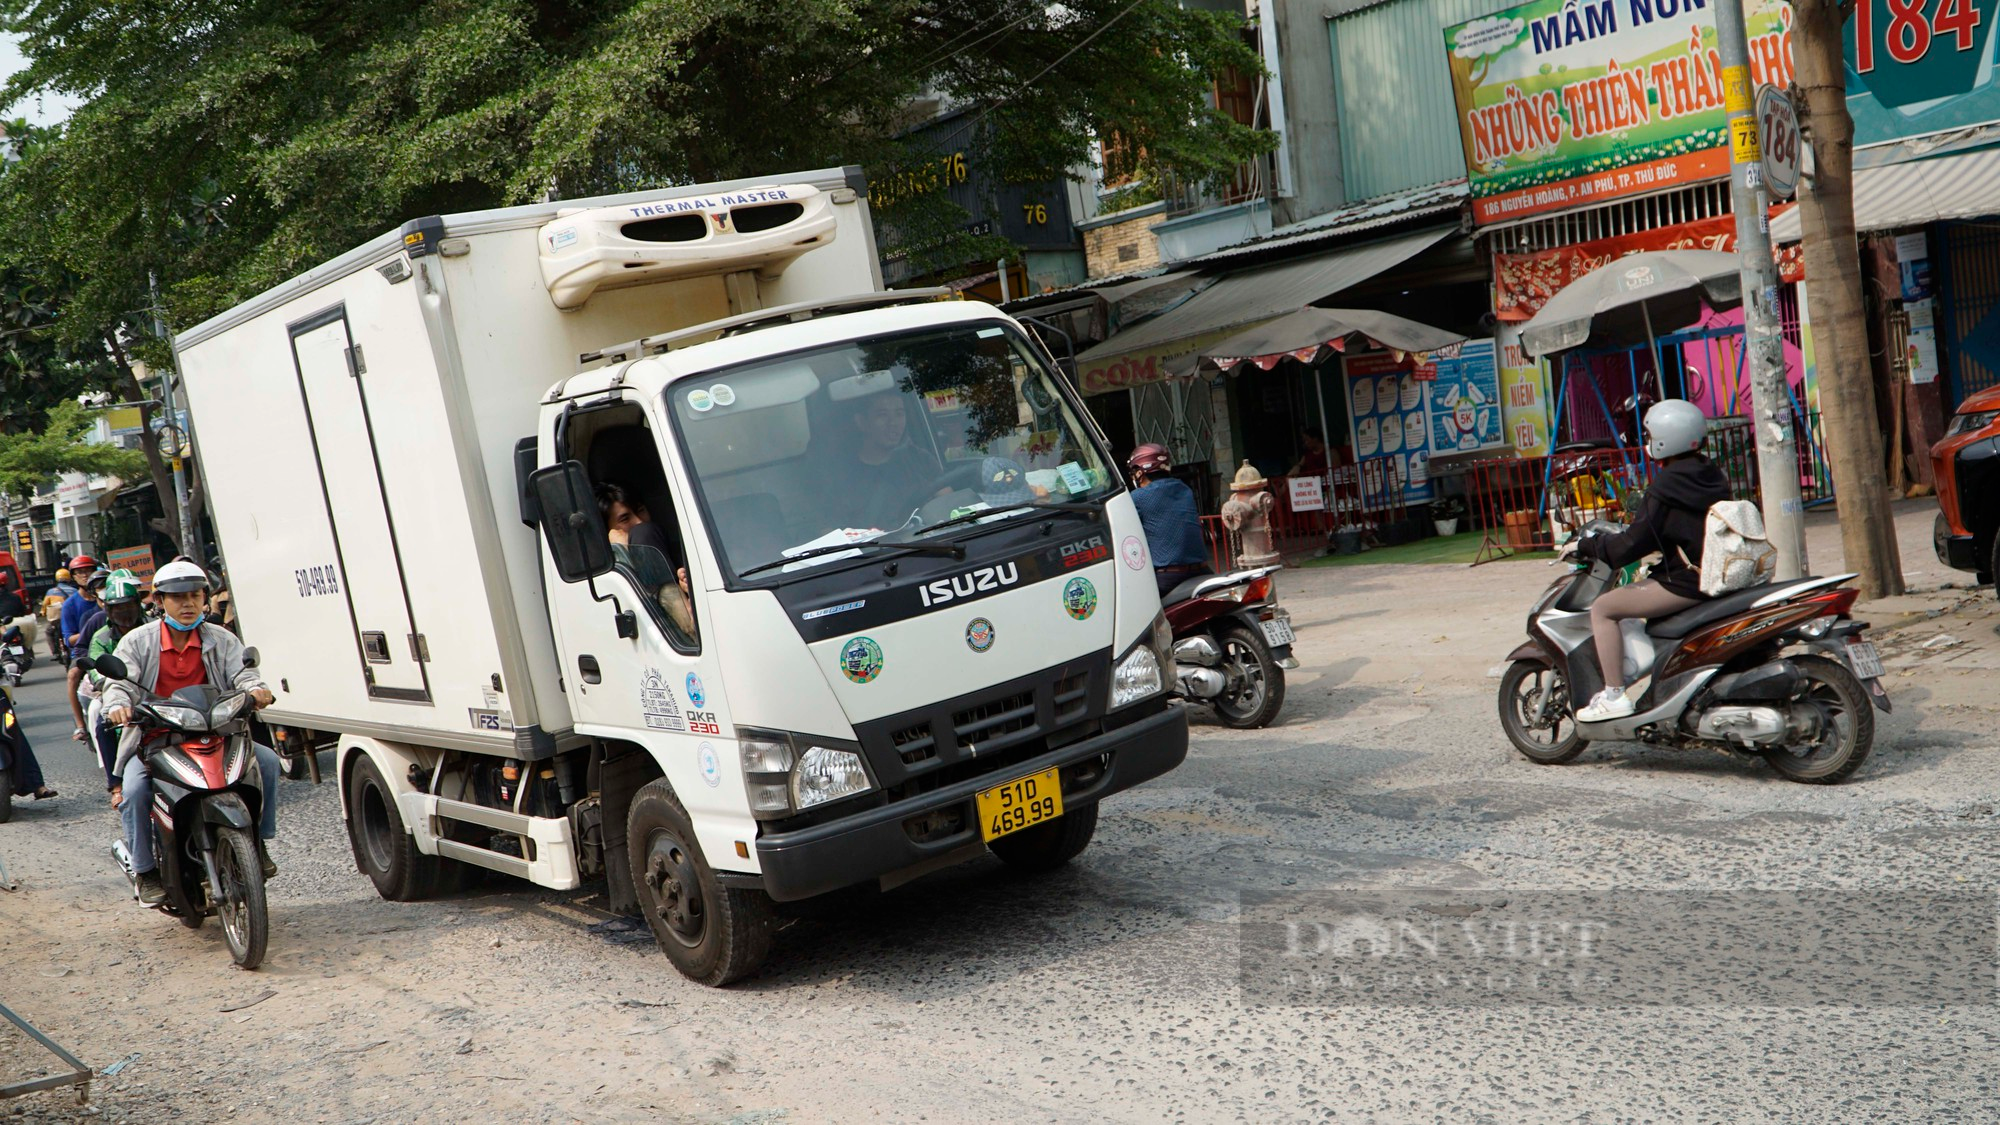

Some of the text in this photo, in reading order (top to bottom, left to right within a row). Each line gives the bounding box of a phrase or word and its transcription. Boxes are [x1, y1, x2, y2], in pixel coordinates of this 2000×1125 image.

[1855, 0, 1980, 74] 184
[1469, 85, 1562, 163] NHỮNG
[1564, 57, 1649, 139] THIÊN
[1738, 130, 1758, 147] 73
[1764, 113, 1796, 170] 184
[942, 152, 967, 187] 76
[1484, 202, 1500, 217] 186
[1569, 186, 1579, 198] P.
[1581, 182, 1593, 196] AN
[1595, 175, 1618, 193] PHÚ,
[1618, 172, 1634, 188] TP.
[1635, 164, 1655, 184] THỦ
[1656, 161, 1678, 181] ĐỨC
[630, 190, 789, 218] THERMAL MASTER
[1022, 203, 1048, 225] 76
[1085, 356, 1158, 391] CƠM
[1460, 412, 1473, 425] 5K
[1060, 535, 1104, 557] QKR
[1062, 545, 1108, 568] 230
[918, 561, 1019, 607] ISUZU
[686, 711, 717, 723] QKR
[689, 722, 720, 735] 230
[999, 779, 1037, 808] 51D
[991, 796, 1054, 835] 469.99
